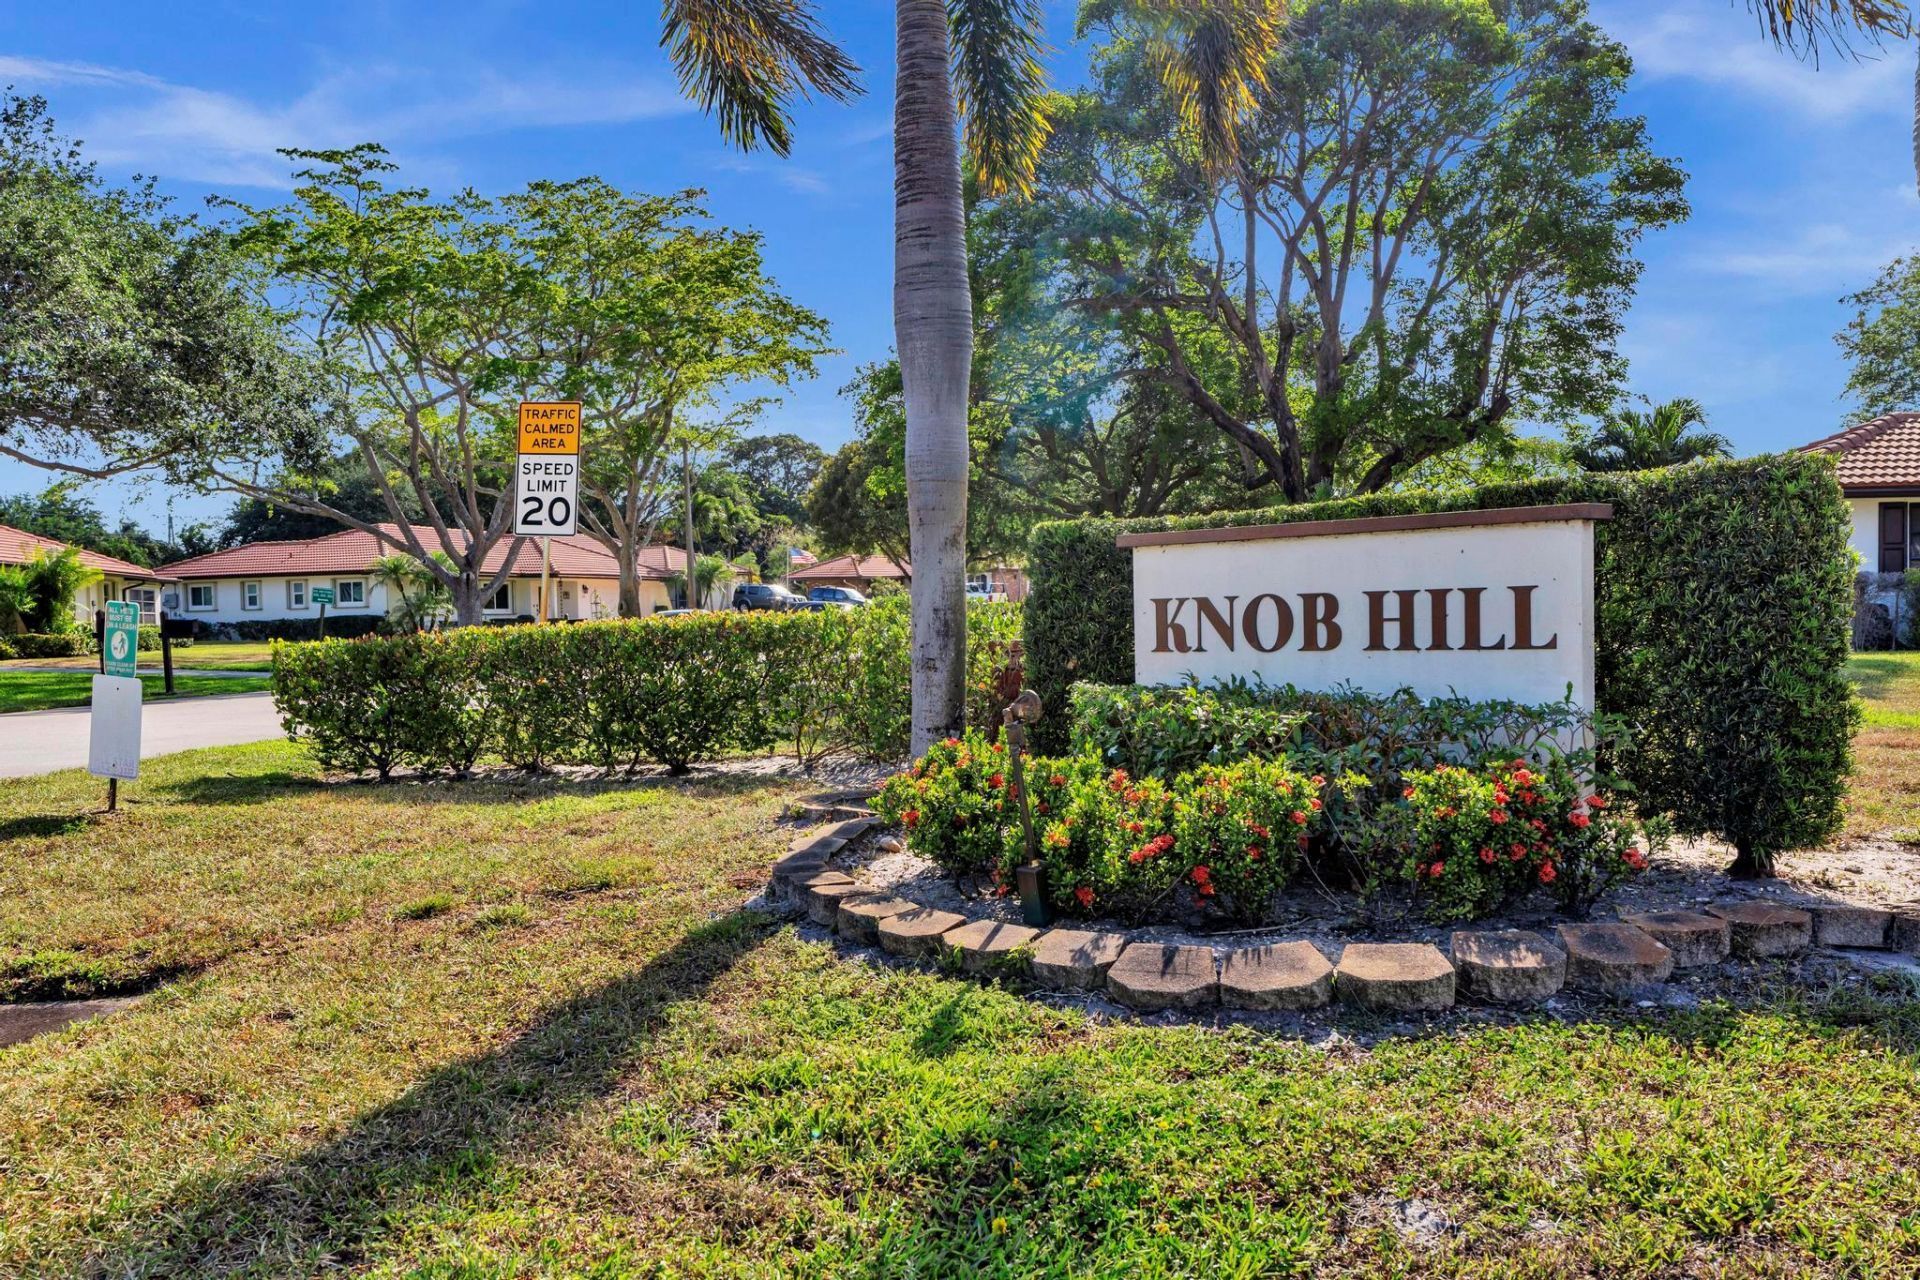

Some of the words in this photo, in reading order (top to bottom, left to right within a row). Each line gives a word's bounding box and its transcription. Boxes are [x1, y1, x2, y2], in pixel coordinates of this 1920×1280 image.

[525, 409, 576, 420] TRAFFIC
[525, 423, 575, 434] CALMED
[532, 438, 566, 449] AREA
[522, 463, 574, 476] SPEED
[527, 480, 567, 492] LIMIT
[521, 496, 571, 526] 20
[1149, 592, 1343, 653] KNOB
[1362, 585, 1558, 651] HILL
